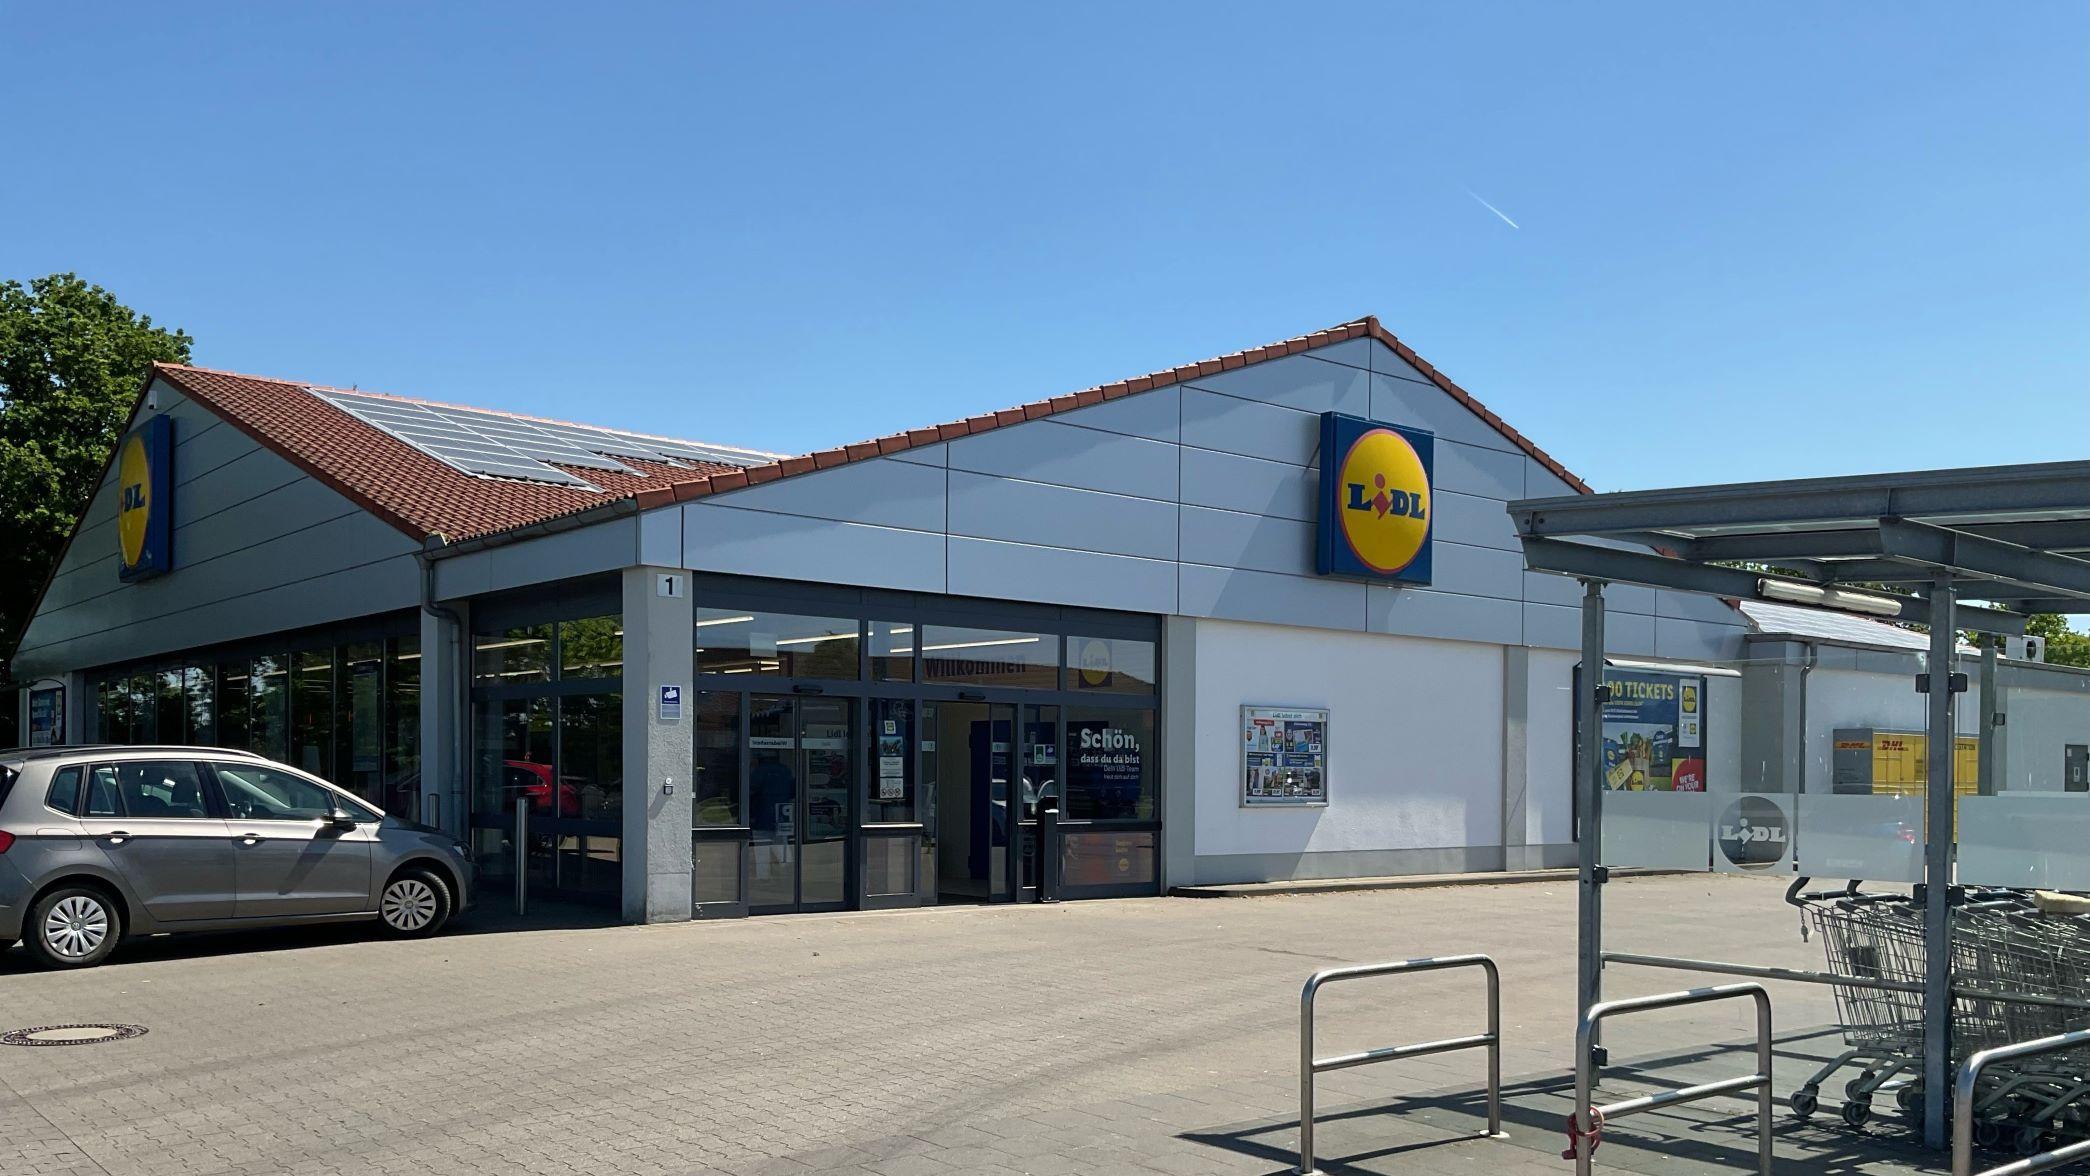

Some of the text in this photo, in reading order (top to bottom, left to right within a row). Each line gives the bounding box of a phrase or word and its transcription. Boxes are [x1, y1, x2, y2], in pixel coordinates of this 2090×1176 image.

[122, 483, 146, 512] DL
[665, 577, 673, 595] 1
[1624, 682, 1674, 700] TICKETS
[1080, 728, 1140, 752] Schön,
[1080, 754, 1140, 764] dass du da bist
